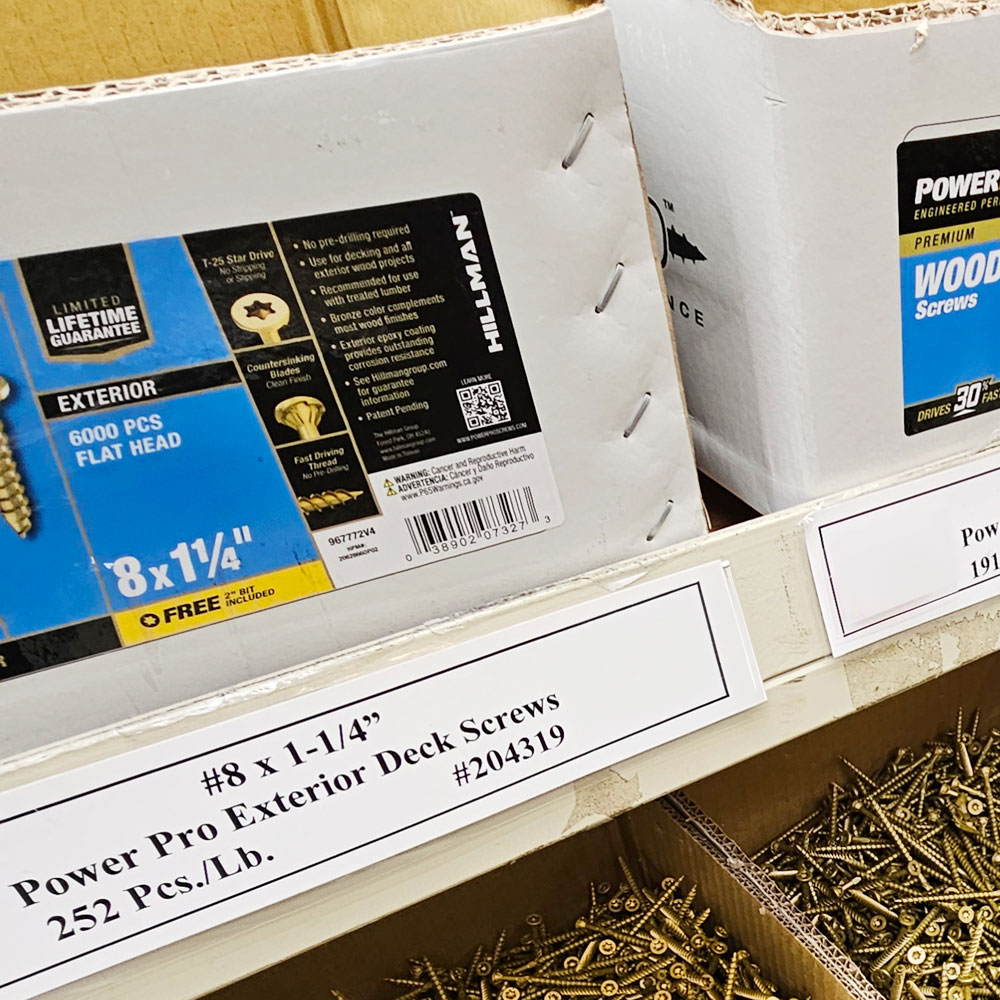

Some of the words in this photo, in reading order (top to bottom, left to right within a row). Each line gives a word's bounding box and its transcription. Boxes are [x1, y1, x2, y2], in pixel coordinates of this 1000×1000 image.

[914, 200, 976, 220] ENGINEERED
[303, 240, 316, 250] No
[319, 232, 371, 249] pre-drilling
[372, 224, 410, 239] required
[915, 227, 975, 250] PREMIUM
[202, 257, 224, 268] T-25
[227, 254, 246, 264] Star
[250, 249, 274, 261] Drive
[309, 257, 327, 267] Use
[329, 254, 342, 263] for
[345, 248, 382, 261] decking
[383, 242, 399, 254] and
[402, 241, 412, 252] all
[314, 267, 350, 279] exterior
[352, 261, 377, 272] wood
[379, 254, 415, 270] projects
[320, 276, 387, 296] Recommended
[388, 274, 401, 283] for
[402, 271, 419, 280] use
[324, 296, 345, 307] with
[346, 289, 379, 303] treated
[380, 284, 412, 298] lumber
[452, 213, 503, 353] HILLMAN
[52, 295, 120, 315] LIMITED
[329, 311, 362, 323] Bronze
[364, 306, 385, 316] color
[388, 294, 445, 312] complements
[915, 293, 978, 320] Screws
[46, 305, 138, 334] LIFETIME
[334, 322, 357, 334] most
[359, 318, 383, 329] wood
[384, 312, 419, 324] finishes
[50, 322, 141, 348] GUARANTEE
[340, 336, 375, 350] Exterior
[377, 331, 402, 343] epoxy
[404, 324, 436, 337] coating
[344, 346, 382, 362] provides
[384, 336, 434, 352] outstanding
[348, 358, 389, 371] corrosion
[391, 347, 435, 362] resistance
[247, 353, 315, 372] Countersinking
[270, 367, 300, 379] Blades
[353, 376, 370, 386] See
[371, 360, 447, 381] Hillmangroup.com
[266, 379, 287, 389] Clean
[290, 374, 312, 384] Finish
[358, 387, 369, 396] for
[372, 379, 414, 395] guarantee
[57, 379, 158, 413] EXTERIOR
[361, 390, 410, 406] information
[366, 408, 394, 420] Patent
[395, 401, 429, 415] Pending
[917, 404, 951, 422] DRIVES
[68, 422, 119, 446] 6000
[123, 414, 163, 435] PCS
[76, 443, 122, 468] FLAT
[130, 432, 181, 457] HEAD
[294, 454, 313, 464] Fast
[315, 447, 344, 460] Driving
[309, 459, 337, 471] Thread
[394, 469, 430, 484] WARNING:
[431, 464, 454, 474] Cancer
[456, 460, 467, 469] and
[468, 450, 508, 467] Reproductive
[510, 445, 526, 455] Harm
[398, 475, 449, 493] ADVERTENCIA:
[495, 453, 534, 469] Reproductivo
[328, 528, 376, 546] 967772V4
[432, 536, 477, 554] 38902
[485, 522, 526, 539] 07327
[970, 553, 999, 579] 191
[226, 588, 275, 607] INCLUDED
[239, 586, 256, 595] BIT
[164, 595, 221, 623] FREE
[452, 724, 565, 786] #204319
[201, 762, 246, 796] #8
[253, 757, 279, 777] x
[8, 849, 139, 908] Power
[144, 822, 218, 859] Pro
[221, 764, 366, 831] Exterior
[372, 732, 456, 776] Deck
[459, 693, 560, 743] Screws
[47, 899, 120, 941] 252
[122, 847, 274, 911] Pcs./Lb.
